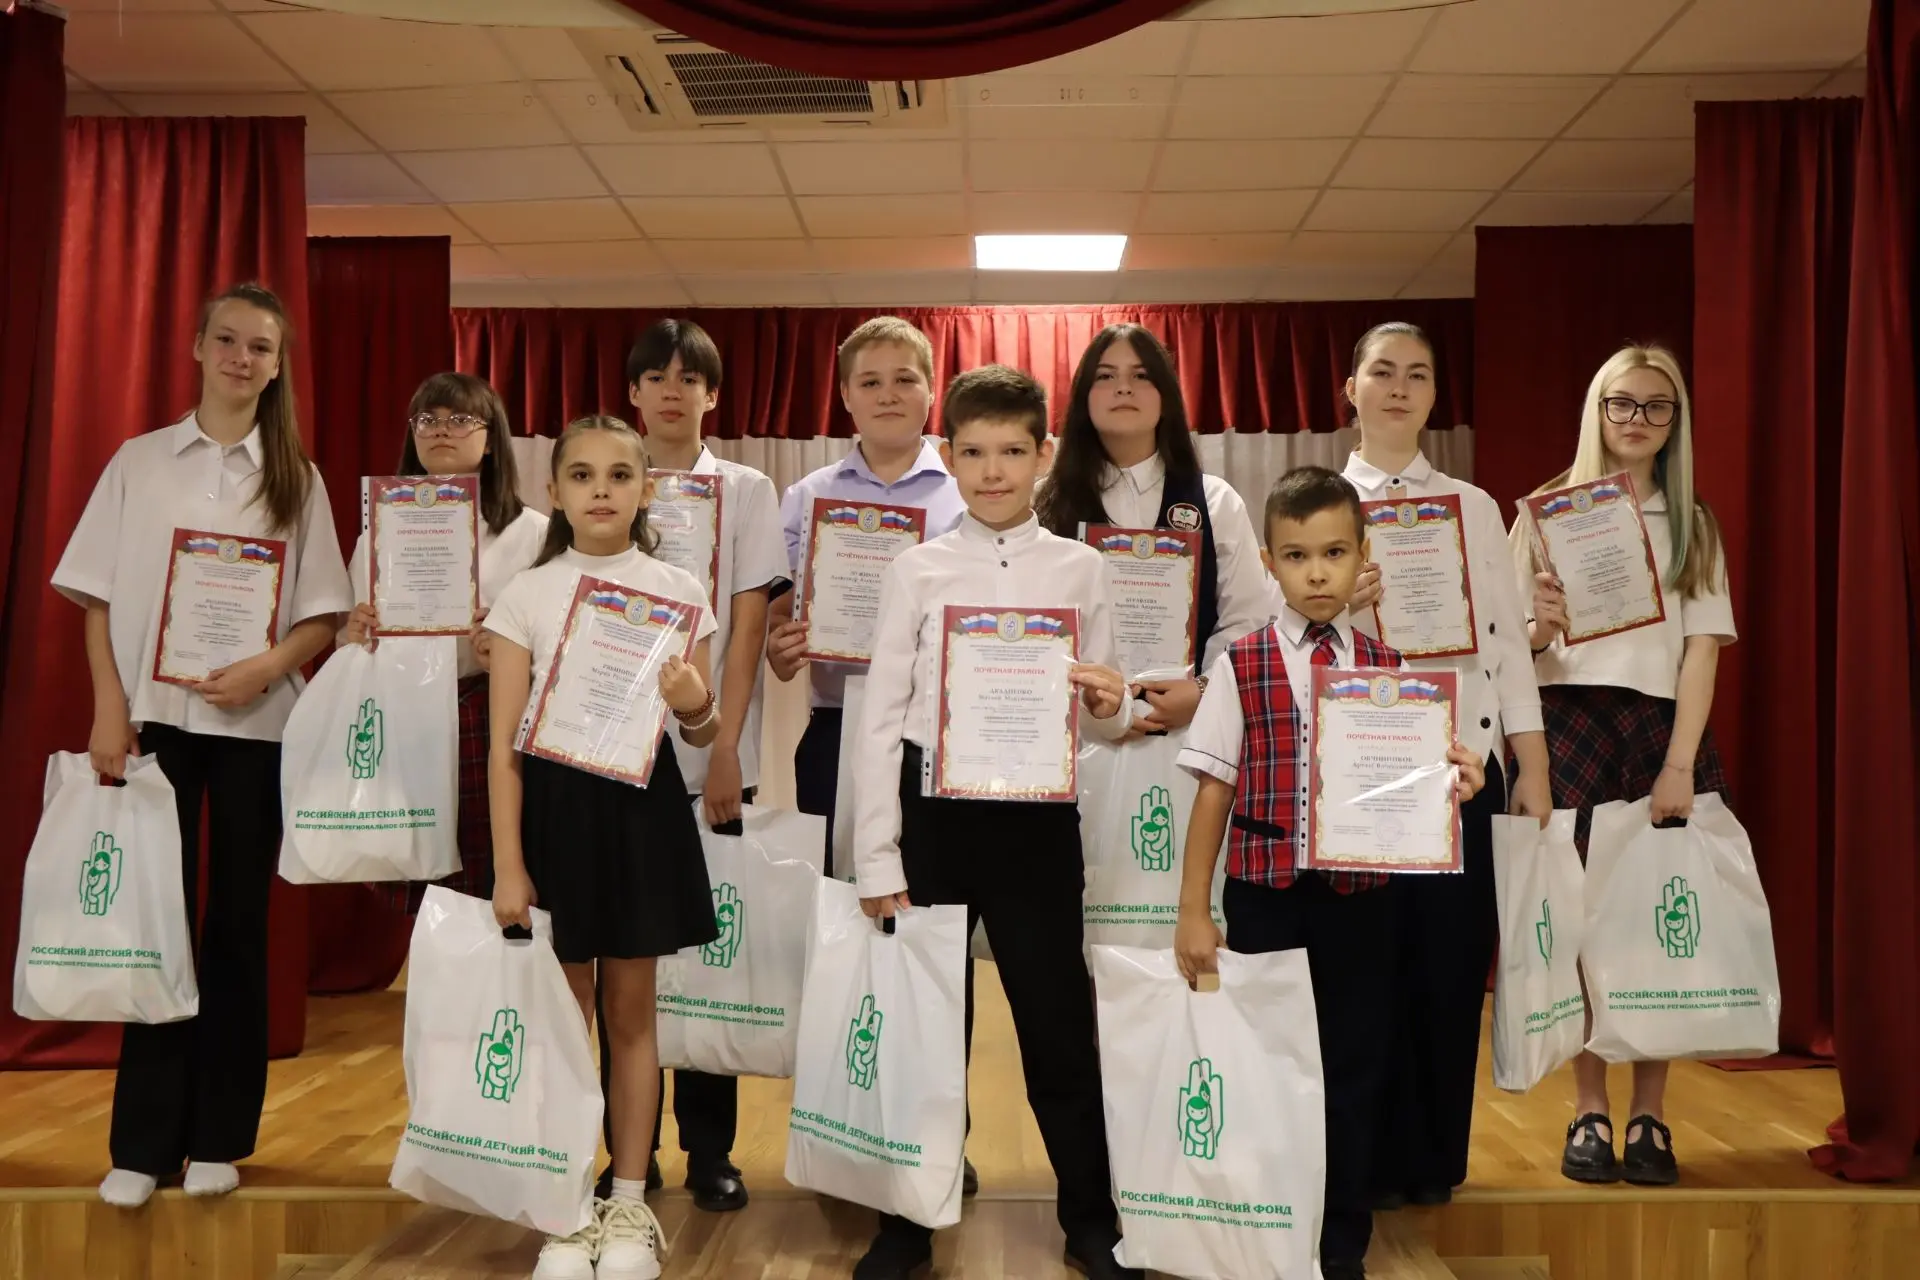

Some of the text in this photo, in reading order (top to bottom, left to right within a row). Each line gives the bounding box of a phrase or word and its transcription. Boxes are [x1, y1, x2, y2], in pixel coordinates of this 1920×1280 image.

[296, 808, 436, 820] РОССИЙСКИЙ ДЕТСКИЙ ФОНД
[1084, 904, 1180, 914] РОССИЙСКИЙ ДЕТС
[32, 946, 162, 960] РОССИЙСКИЙ ДЕТСКИЙ ФОНД
[1608, 987, 1759, 1000] РОССИЙСКИЙ ДЕТСКИЙ ФОНД
[657, 994, 785, 1016] ССИЙСКИЙ ДЕТСКИЙ ФОНД
[1666, 1002, 1721, 1010] РЕГИОНАЛЬНОЕ
[656, 1007, 694, 1018] ГОГРАДСКОЕ
[694, 1012, 746, 1024] РЕГИОНАЛЬНОЕ
[790, 1107, 922, 1155] РОССИЙСКИЙ ДЕТСКИЙ ФОНД
[407, 1122, 568, 1162] РОССИЙСКИЙ ДЕТСКИЙ ФОНД
[834, 1138, 878, 1158] РЕГИОНАЛЬНОЕ
[406, 1137, 568, 1174] ВОЛГОГРАДСКОЕ РЕГИОНАЛЬНОЕ ОТДЕЛЕНИЕ
[1120, 1190, 1292, 1216] РОССИЙСКИЙ ДЕТСКИЙ ФОНД
[1182, 1213, 1242, 1227] РЕГИОНАЛЬНОЕ
[1244, 1220, 1293, 1230] ОТДЕЛЕНИЕ
